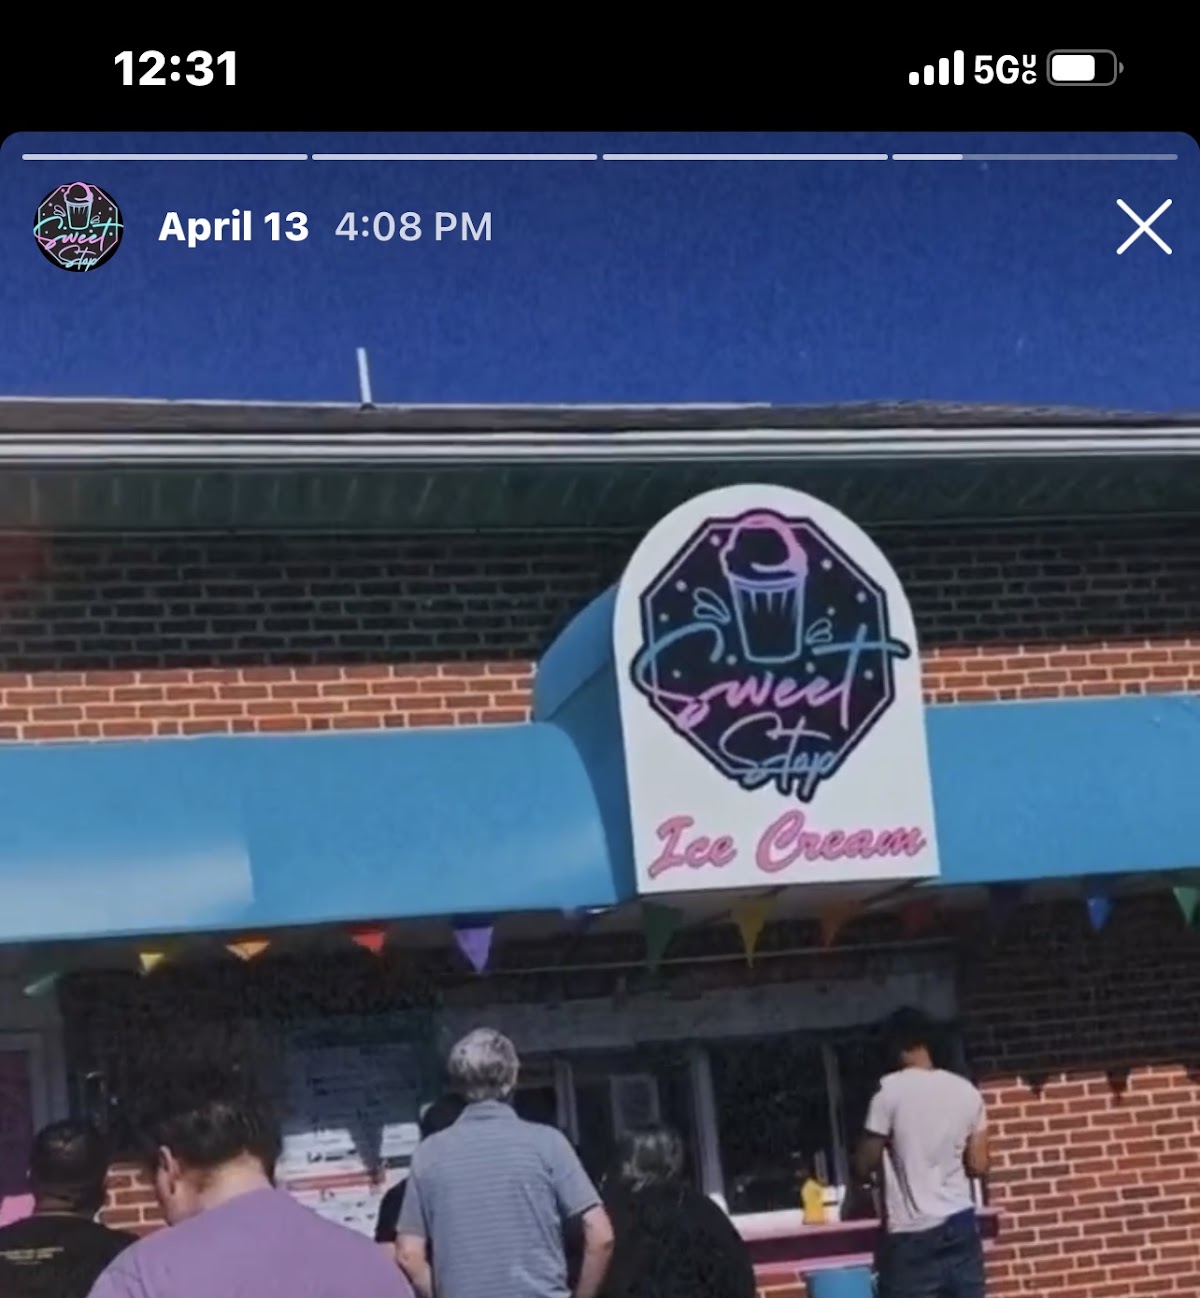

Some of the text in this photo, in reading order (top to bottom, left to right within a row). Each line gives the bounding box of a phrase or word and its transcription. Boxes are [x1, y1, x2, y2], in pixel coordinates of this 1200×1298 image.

[636, 622, 909, 730] Sweet
[718, 711, 836, 798] Stop
[648, 809, 927, 879] Ice Cream
